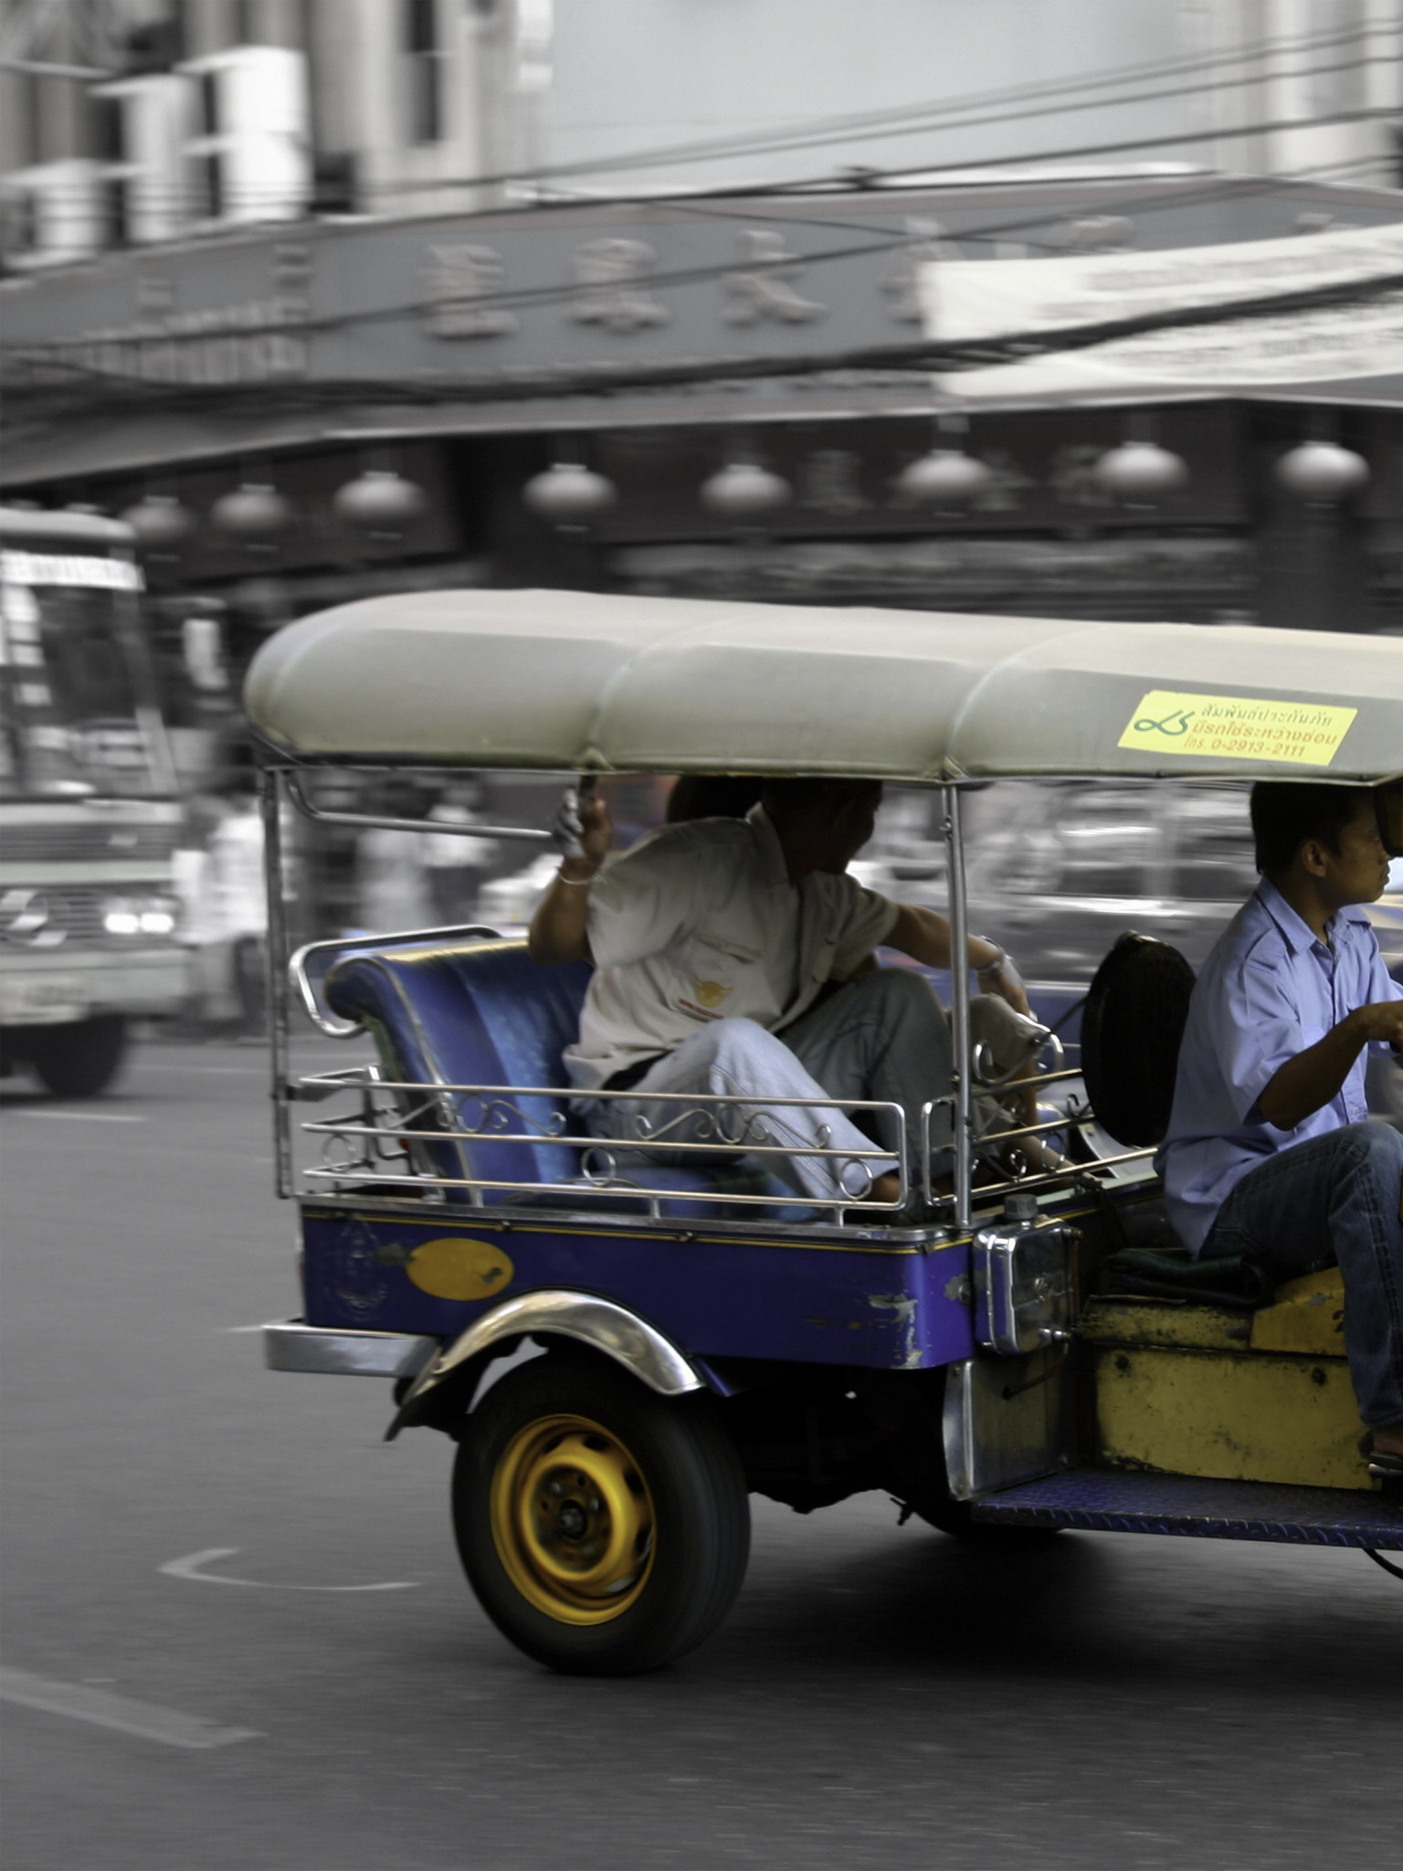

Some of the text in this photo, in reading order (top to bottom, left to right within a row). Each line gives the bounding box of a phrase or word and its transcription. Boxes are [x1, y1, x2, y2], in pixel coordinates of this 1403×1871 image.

[1201, 703, 1332, 727] สัมพันธ์ประกันภัย
[1191, 719, 1338, 746] มีรถใช้ระหว่างซ่อม
[1211, 739, 1307, 758] 0-2913-2111
